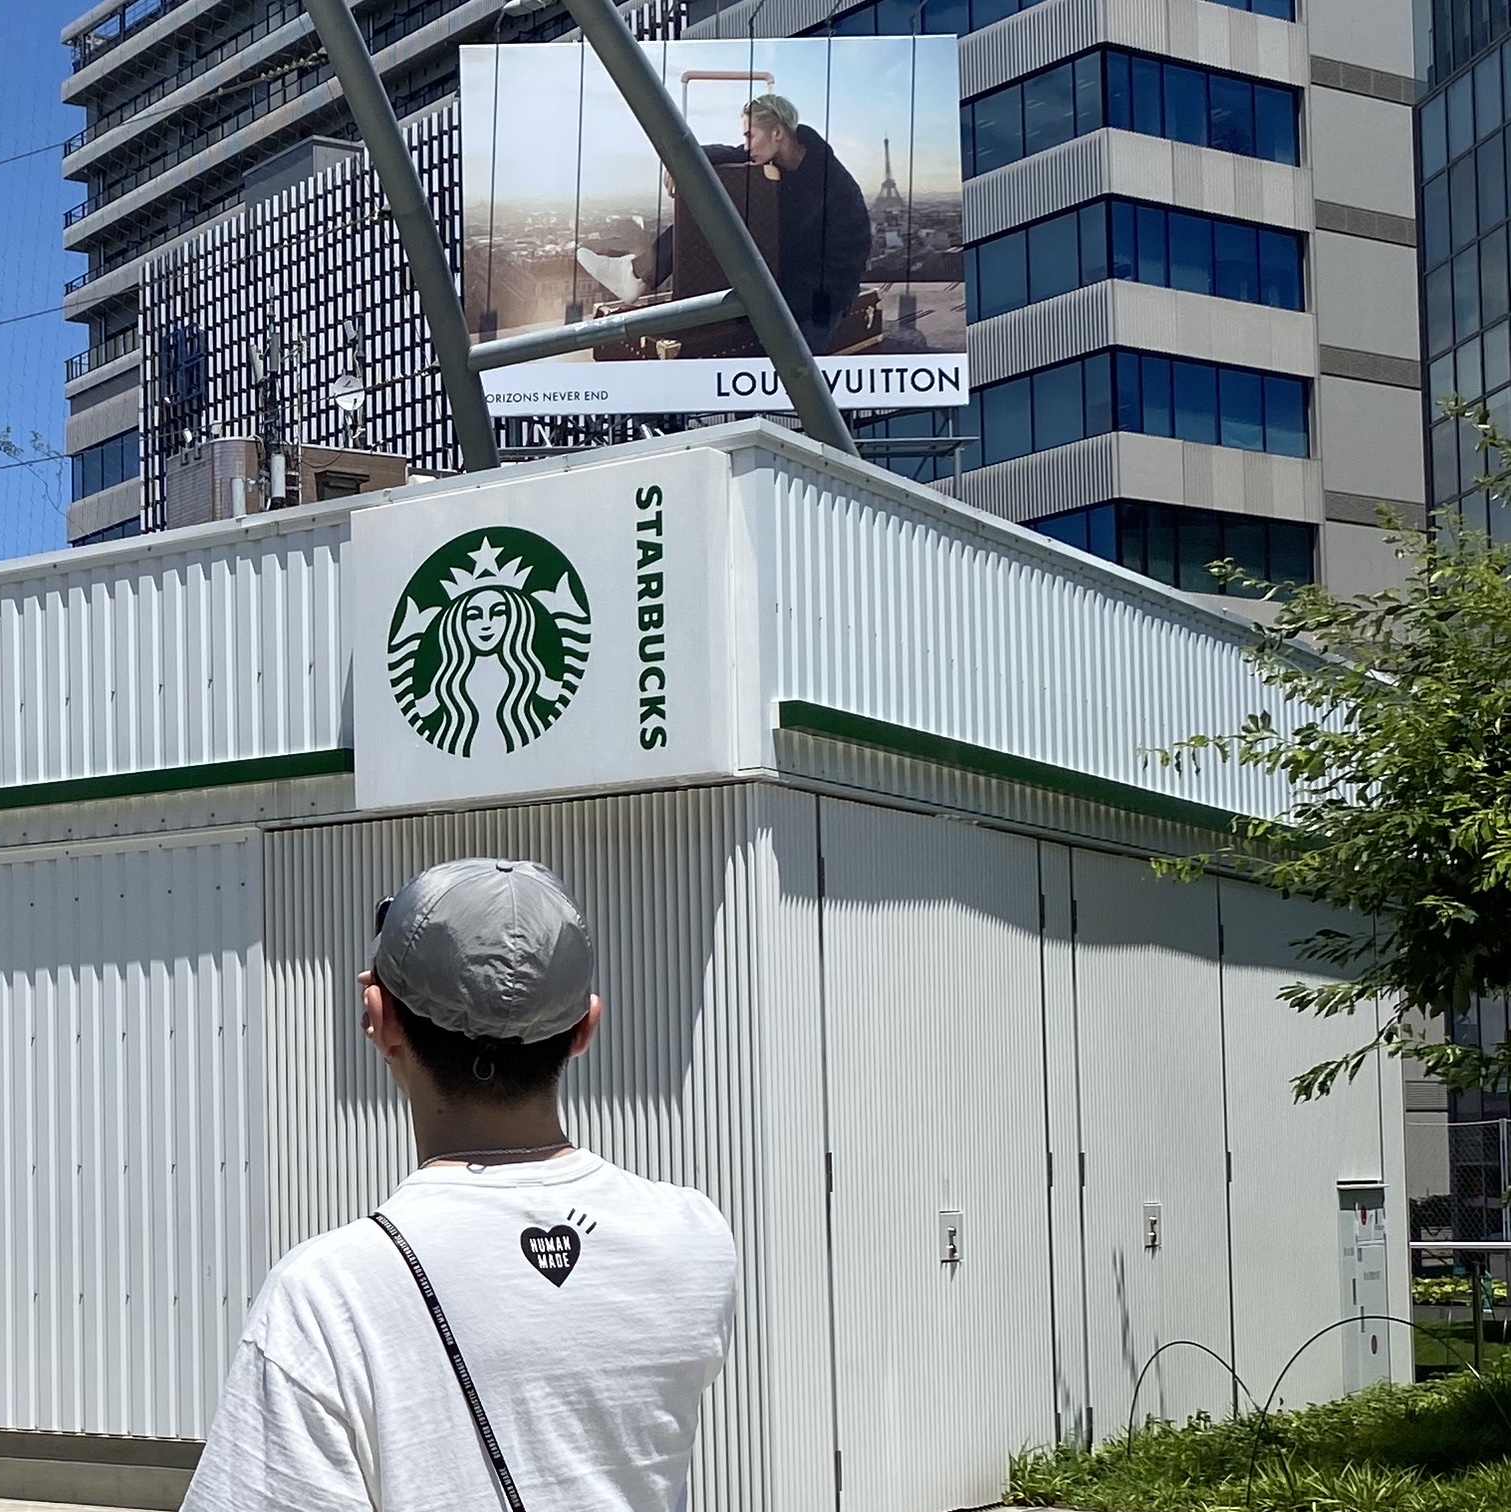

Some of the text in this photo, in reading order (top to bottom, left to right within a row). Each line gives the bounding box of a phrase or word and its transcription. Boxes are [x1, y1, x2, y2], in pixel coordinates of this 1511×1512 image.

[717, 366, 960, 397] LOU VUITTON
[485, 391, 609, 404] ORIZONS NEVER END
[636, 485, 667, 751] STARBUCKS
[529, 1235, 571, 1253] HUMAN
[537, 1252, 571, 1269] MADE
